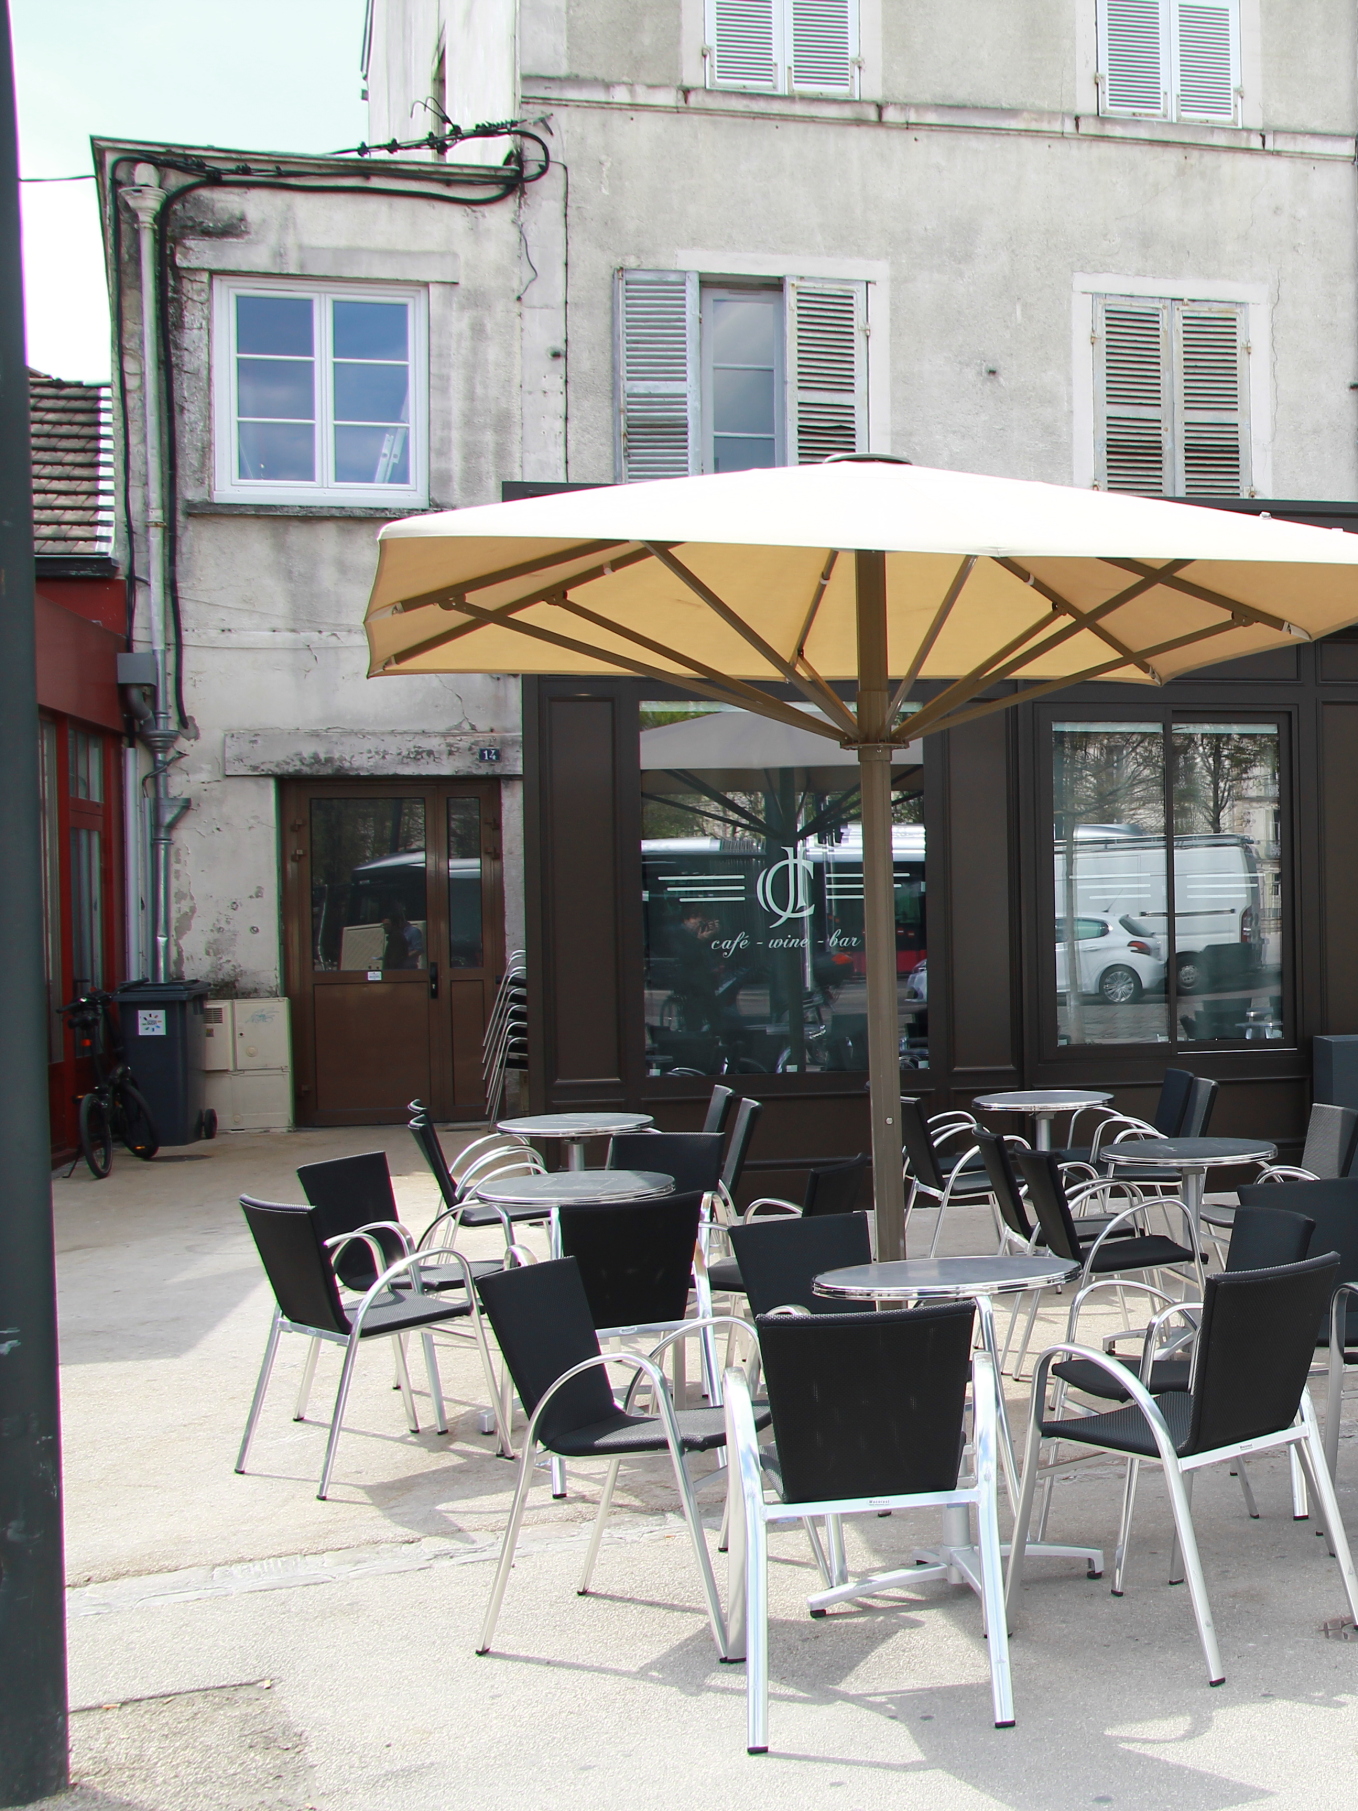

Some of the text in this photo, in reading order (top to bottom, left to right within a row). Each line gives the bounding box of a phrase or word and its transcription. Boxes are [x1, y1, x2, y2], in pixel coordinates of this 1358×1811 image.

[483, 749, 496, 761] 14
[711, 931, 750, 957] café
[768, 934, 809, 948] wine
[829, 929, 861, 947] bar
